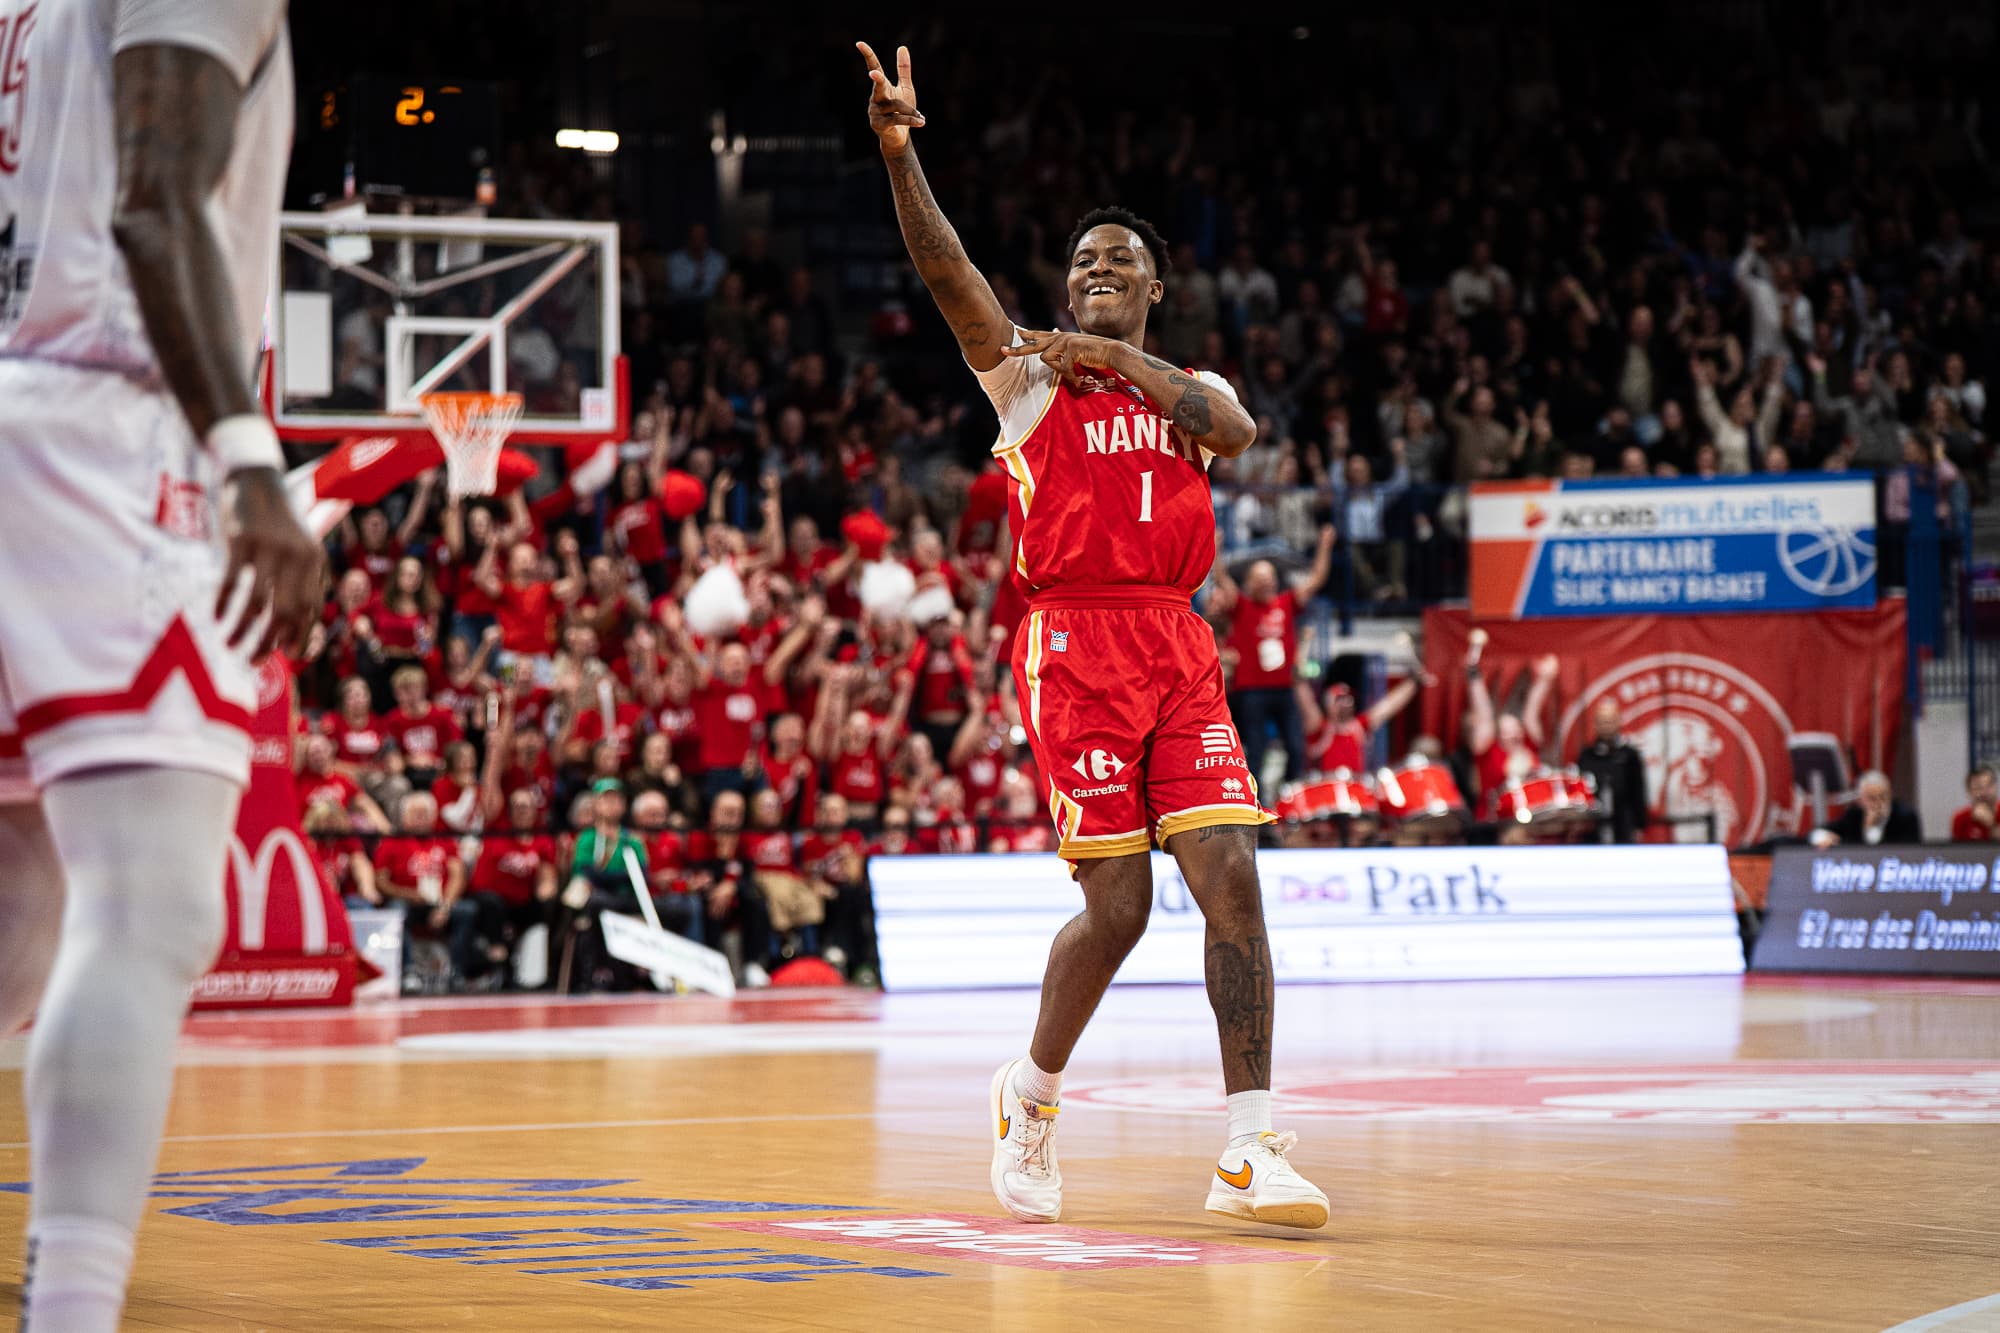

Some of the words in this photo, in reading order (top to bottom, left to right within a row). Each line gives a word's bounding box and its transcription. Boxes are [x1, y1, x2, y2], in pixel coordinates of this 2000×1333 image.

[1138, 470, 1153, 522] 1
[1554, 537, 1716, 575] PARTENAIRE
[1610, 576, 1683, 604] NANCY
[1684, 571, 1766, 602] BASKET
[1072, 783, 1128, 798] Carrefour
[1366, 864, 1508, 915] Park
[1812, 857, 1875, 892] Votre
[1876, 856, 1988, 905] Boutique
[1827, 917, 1869, 948] rue
[1868, 911, 1913, 949] des
